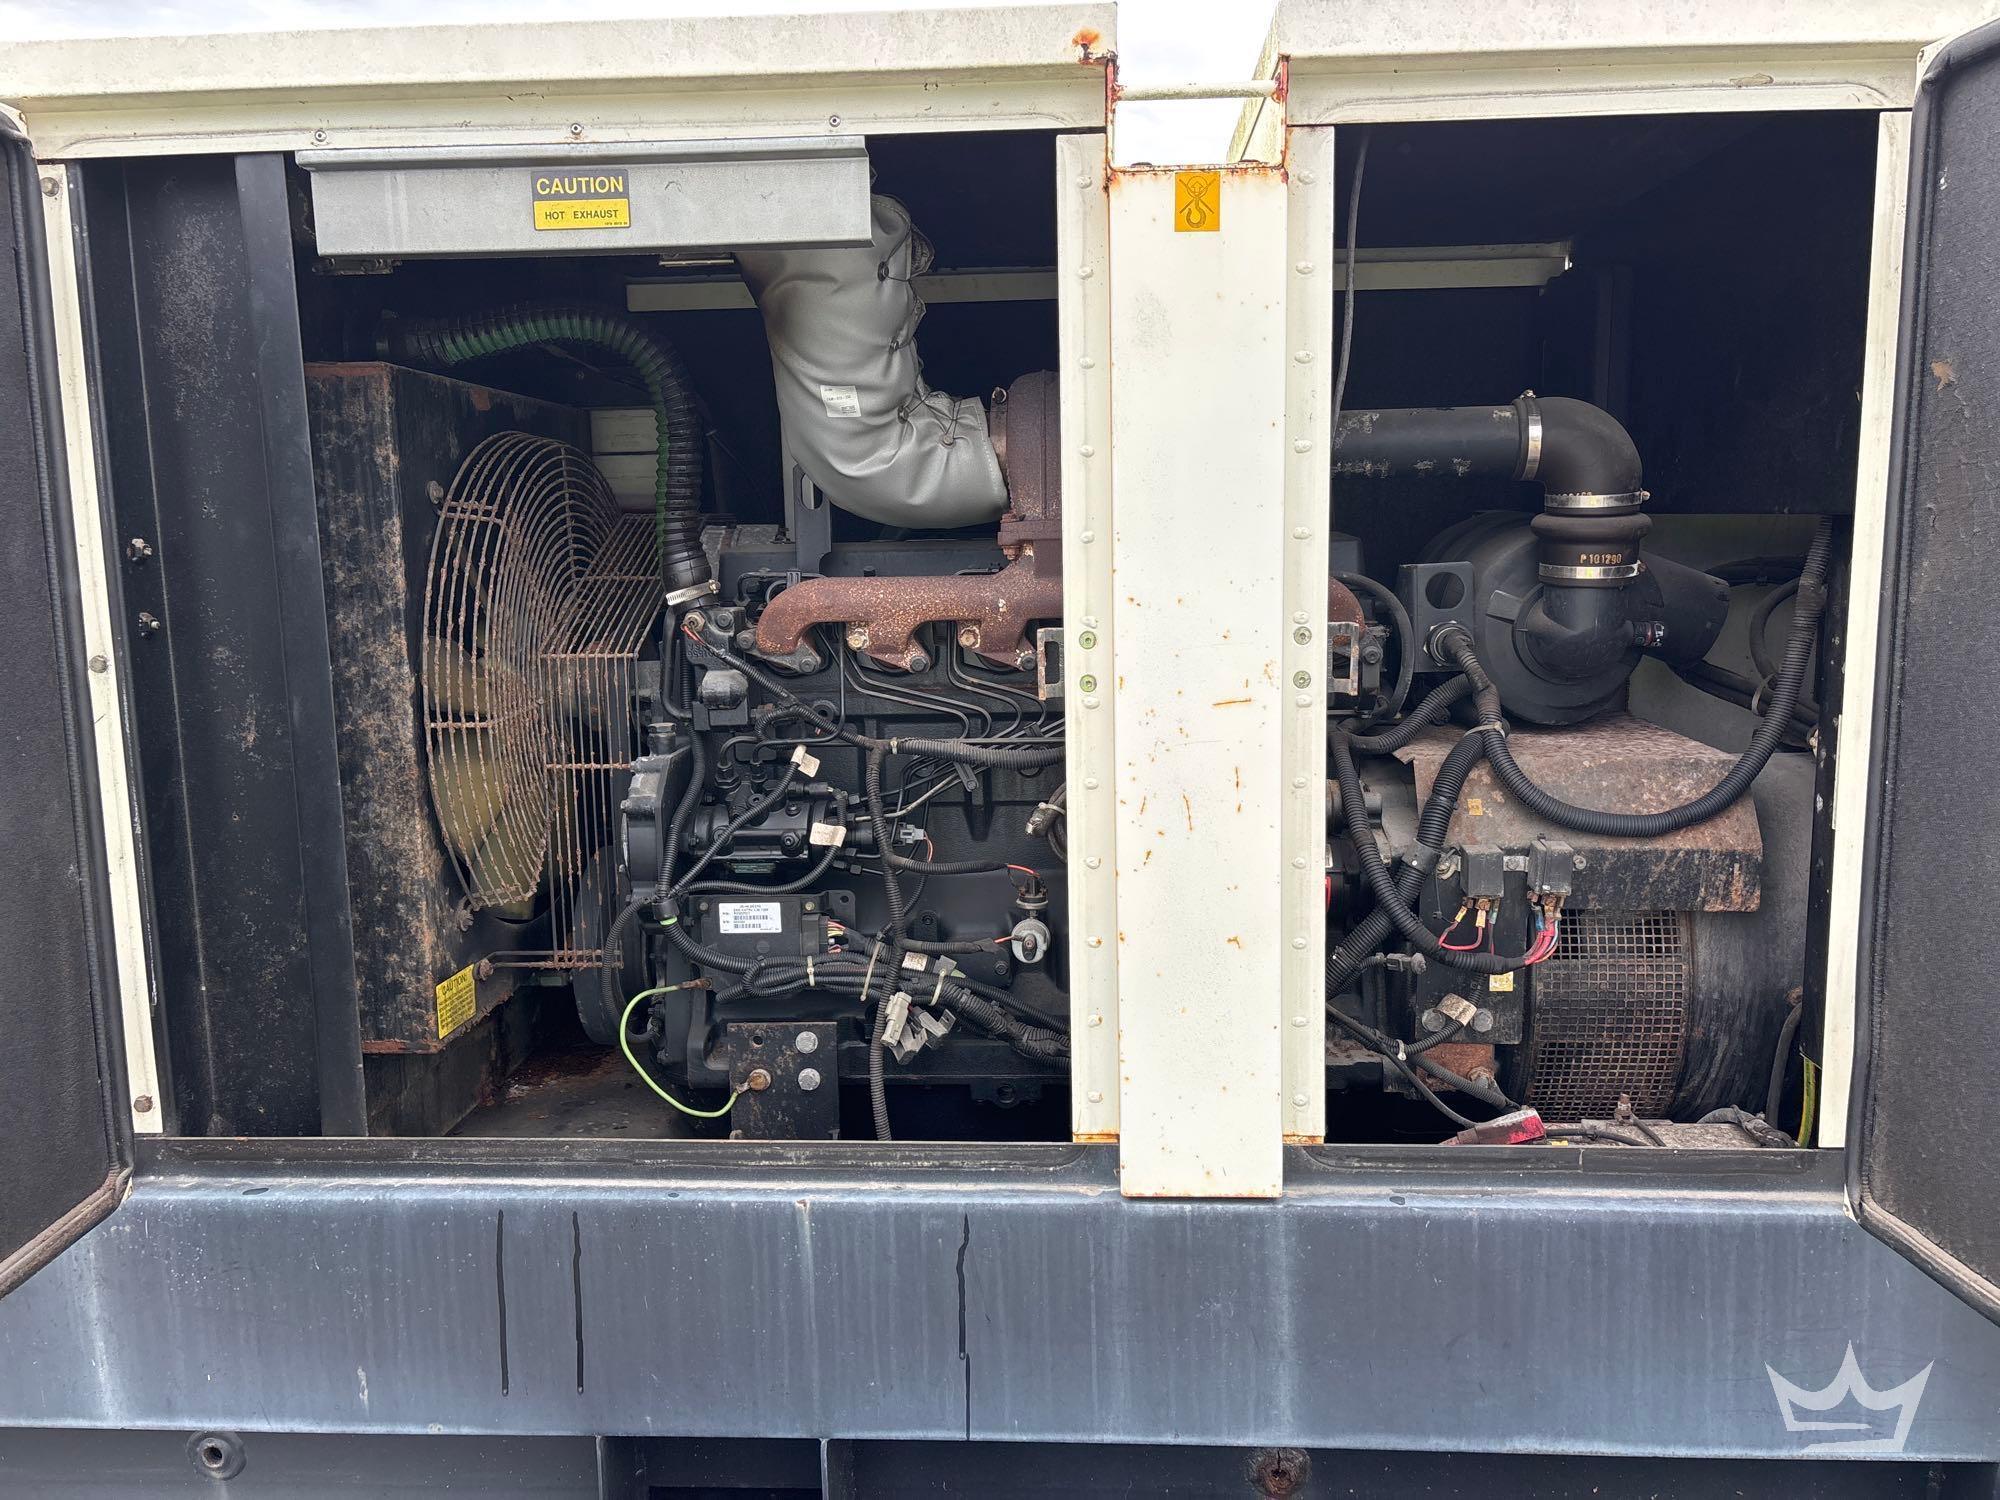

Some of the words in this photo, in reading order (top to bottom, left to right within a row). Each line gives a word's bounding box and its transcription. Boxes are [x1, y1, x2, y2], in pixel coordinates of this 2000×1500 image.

[536, 176, 624, 195] CAUTION
[545, 211, 565, 220] HOT
[573, 209, 619, 220] EXHAUST
